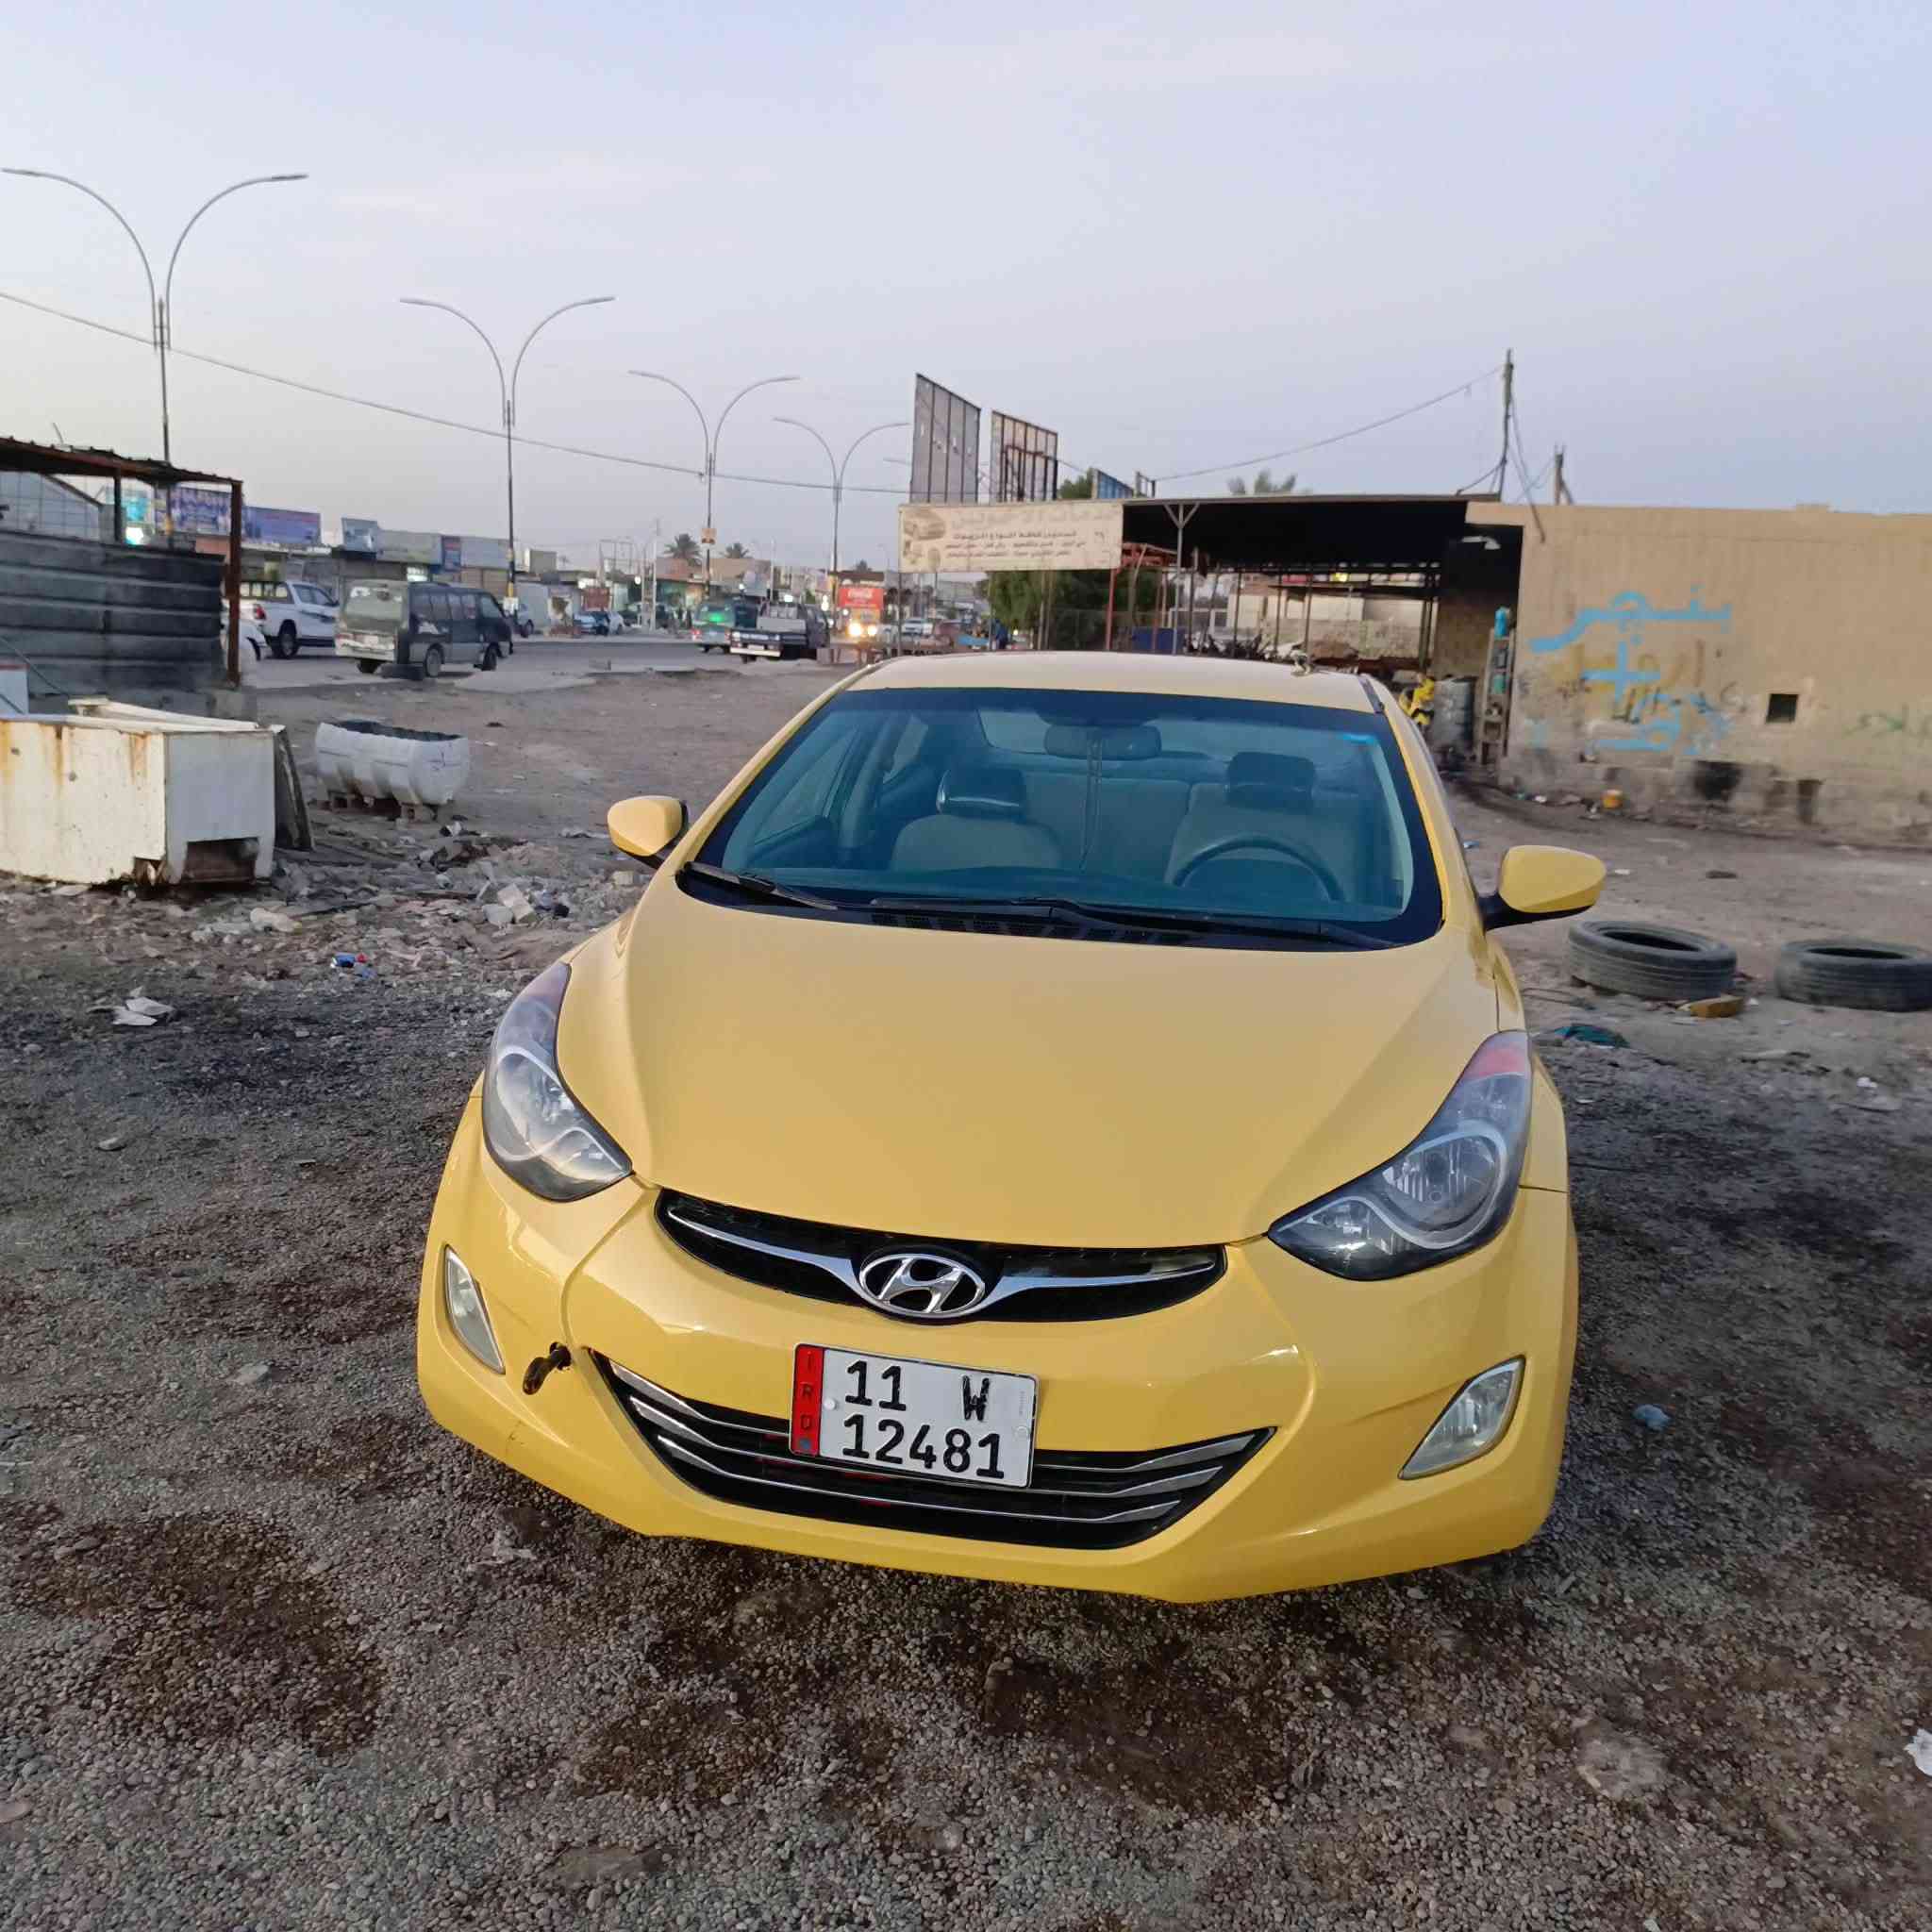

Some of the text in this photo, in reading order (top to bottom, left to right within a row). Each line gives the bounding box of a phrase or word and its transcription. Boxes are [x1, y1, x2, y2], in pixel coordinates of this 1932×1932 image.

[844, 1359, 907, 1412] 11
[961, 1374, 990, 1422] W
[842, 1413, 1005, 1479] 12481
